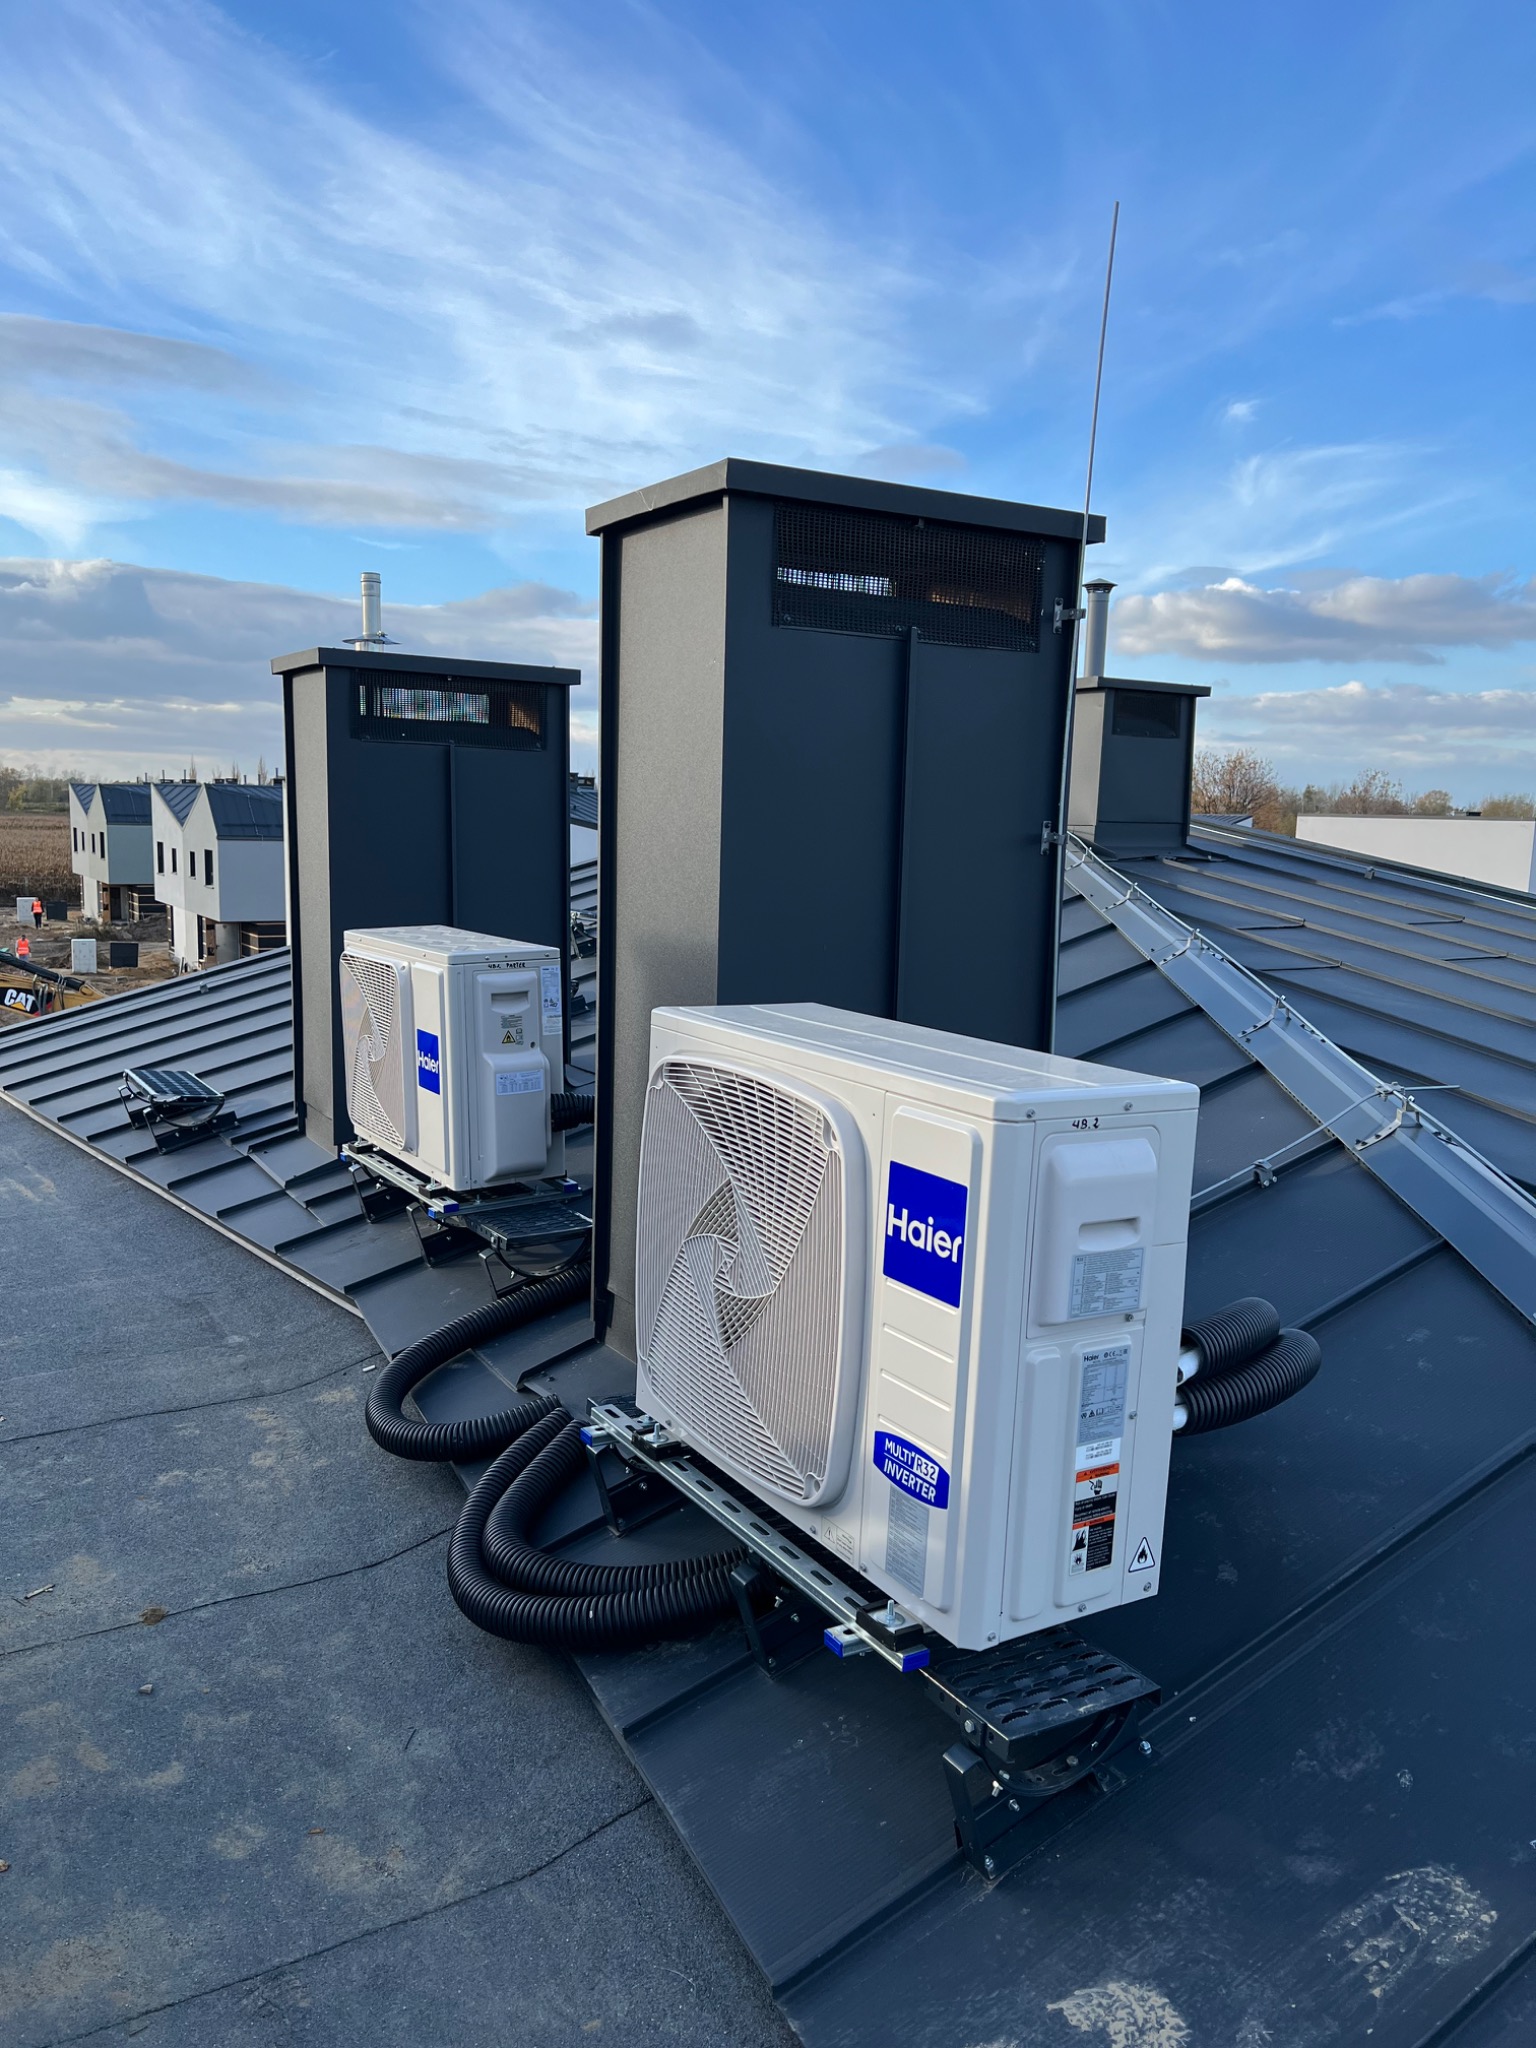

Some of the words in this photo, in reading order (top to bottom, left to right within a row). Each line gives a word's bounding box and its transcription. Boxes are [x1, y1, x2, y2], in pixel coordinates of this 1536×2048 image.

[4, 988, 36, 1012] CAT
[417, 1050, 439, 1074] Haier
[887, 1203, 962, 1263] Haier
[1084, 1354, 1100, 1362] Haier
[884, 1458, 937, 1503] INVERTER
[915, 1455, 937, 1482] R32
